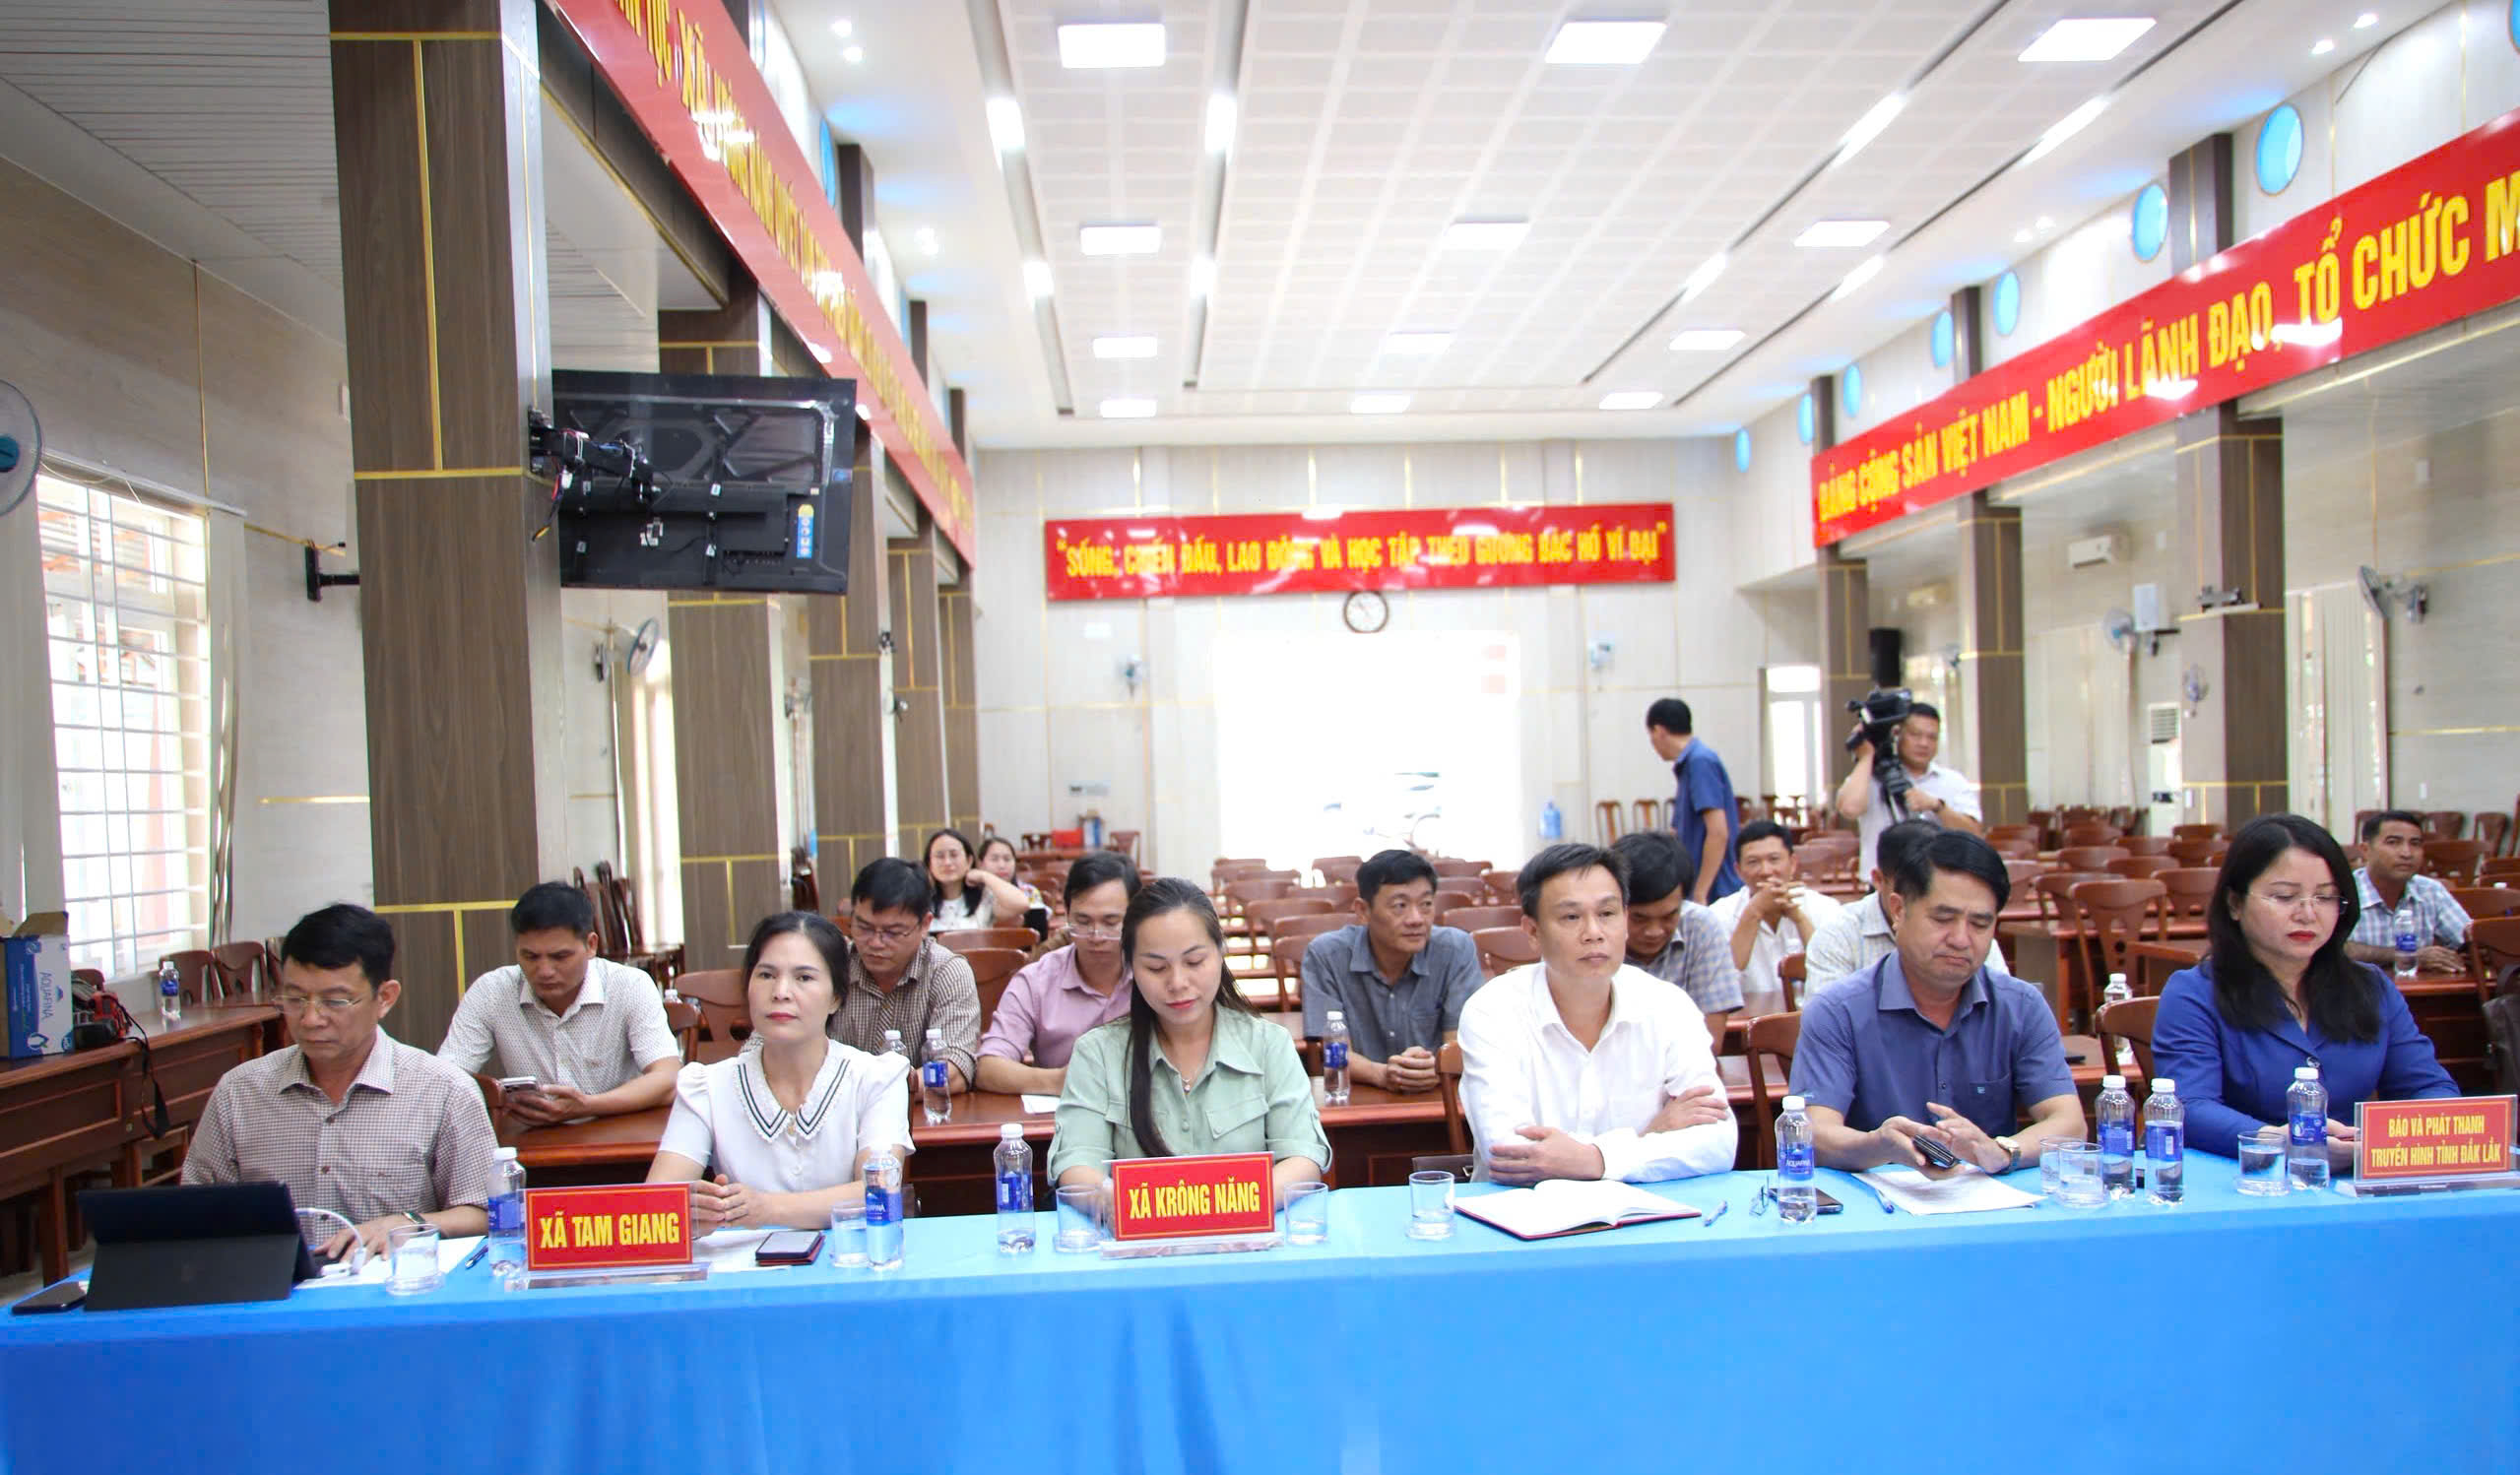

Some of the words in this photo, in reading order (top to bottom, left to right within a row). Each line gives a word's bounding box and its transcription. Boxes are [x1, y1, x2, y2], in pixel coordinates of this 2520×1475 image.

[1819, 463, 1857, 523] ĐẢNG
[1858, 448, 1900, 513] CỘNG
[1902, 421, 1939, 489] SẢN
[1941, 408, 1979, 478] VIỆT
[1982, 390, 2031, 458] NAM
[2047, 340, 2119, 433] NGƯỜI
[2125, 313, 2200, 402] LÃNH
[2294, 216, 2344, 327] TỔ
[2352, 191, 2471, 311] CHỨC
[1227, 540, 1261, 572] LAO
[1320, 532, 1342, 569] VÀ
[1347, 537, 1383, 574] HỌC
[1388, 531, 1420, 572] TẬP
[1425, 535, 1470, 566] THEO
[1475, 533, 1533, 565] GƯƠNG
[40, 971, 53, 1022] AQUAFINA
[2388, 1114, 2409, 1138] BÁO
[2410, 1114, 2423, 1137] VÀ
[2425, 1112, 2451, 1136] PHÁT
[2453, 1115, 2486, 1135] THANH
[2371, 1141, 2409, 1168] TRUYỀN
[2410, 1142, 2434, 1166] HÌNH
[2436, 1139, 2459, 1166] TỈNH
[1129, 1182, 1152, 1220] XÃ
[1155, 1180, 1211, 1218] KRÔNG
[1214, 1177, 1260, 1214] NĂNG
[540, 1210, 568, 1250] XÃ
[571, 1214, 614, 1249] TAM
[618, 1212, 680, 1247] GIANG
